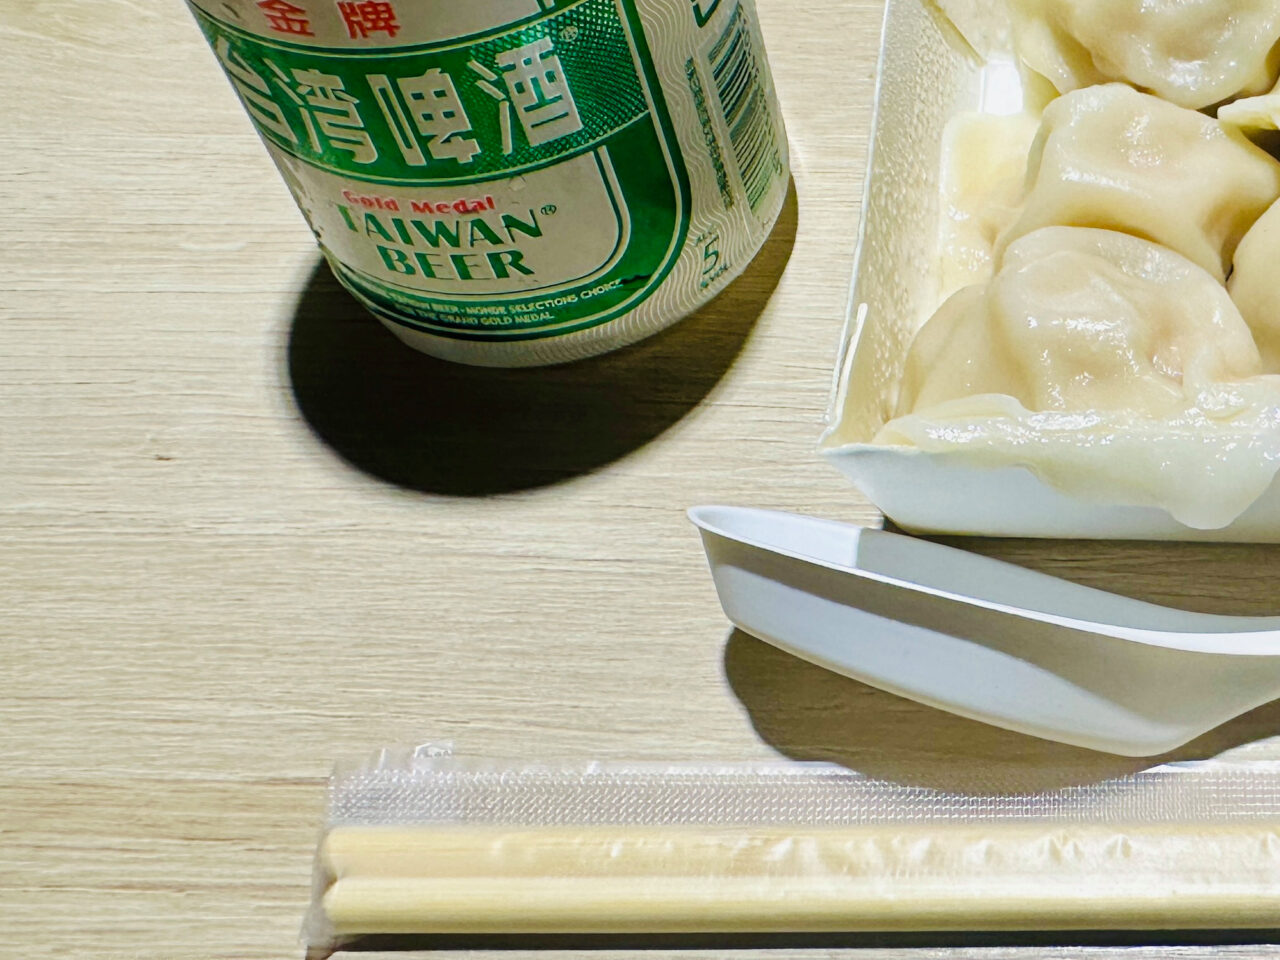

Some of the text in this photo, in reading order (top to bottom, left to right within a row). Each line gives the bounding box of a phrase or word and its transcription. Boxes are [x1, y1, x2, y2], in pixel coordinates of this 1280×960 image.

[342, 190, 496, 215] Gold Medal
[334, 203, 543, 248] TAIWAN
[376, 244, 535, 280] BEER
[514, 311, 555, 324] MEDAL
